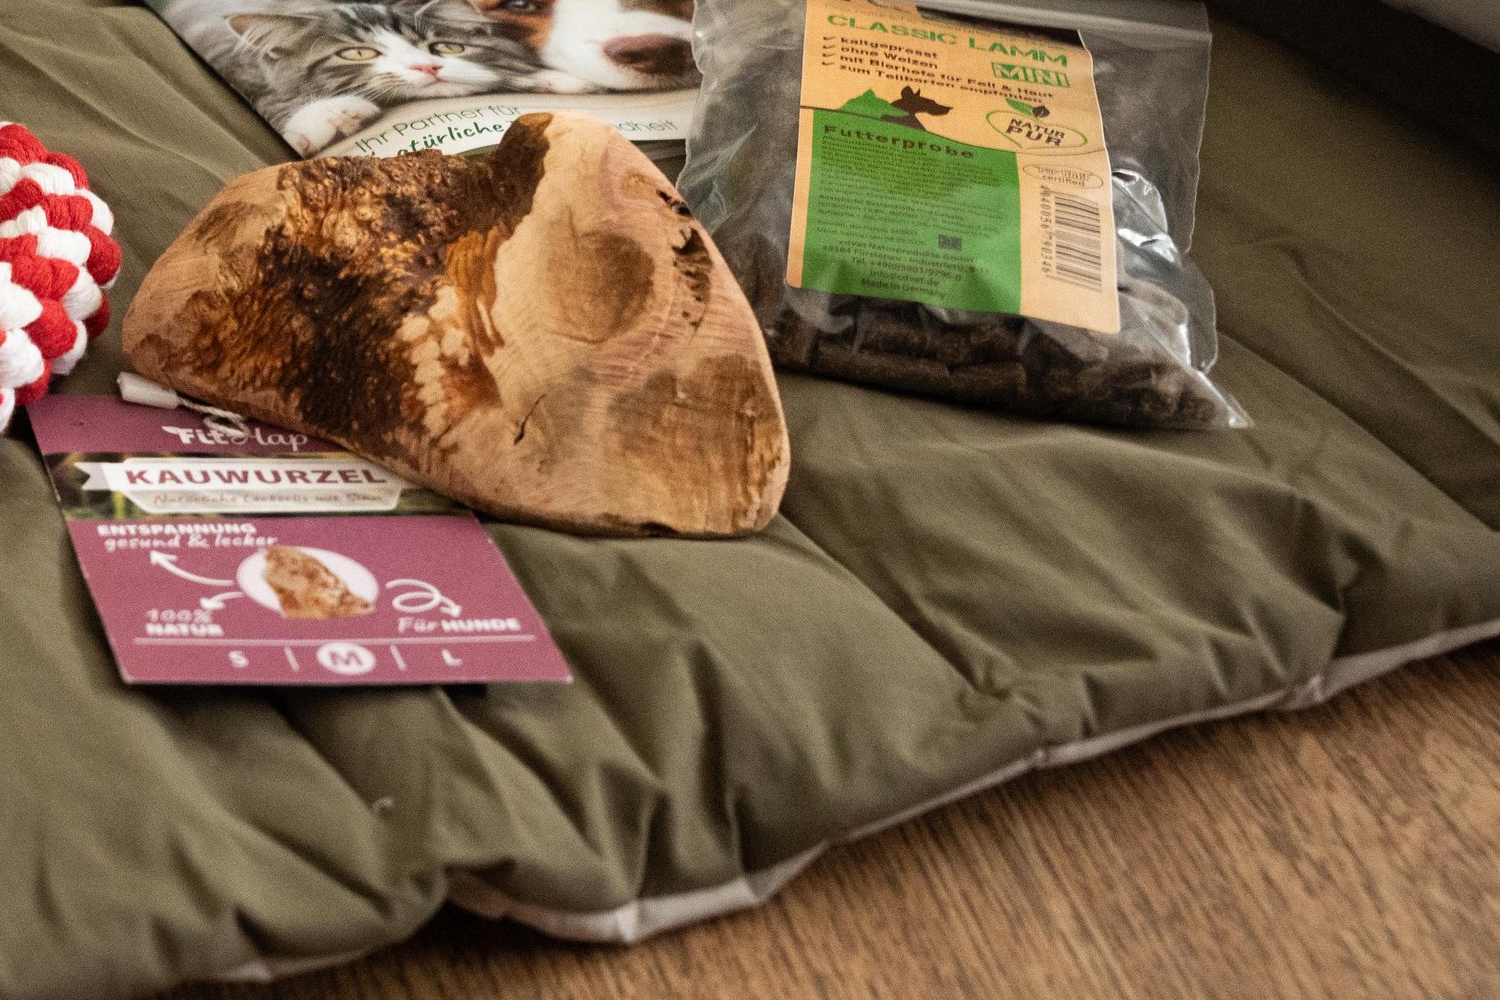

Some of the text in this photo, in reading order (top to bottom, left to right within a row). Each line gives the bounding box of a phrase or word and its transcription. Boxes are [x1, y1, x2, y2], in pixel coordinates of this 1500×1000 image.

[827, 14, 1068, 68] CLASSIC LAMM
[840, 37, 938, 59] kaltgepresst
[840, 46, 938, 69] ohne Weizen
[840, 55, 864, 64] mit
[355, 131, 389, 152] Ihr
[392, 108, 484, 136] Partner
[488, 105, 522, 117] für
[1006, 125, 1062, 147] PUR
[1010, 118, 1065, 139] NATUR
[370, 121, 505, 157] atürliche
[824, 125, 974, 158] Futterprobe
[125, 469, 387, 485] KAUWURZEL
[97, 523, 257, 537] ENTSPANNUNG
[104, 533, 278, 551] gesund & lecker
[146, 608, 212, 624] 100%
[398, 616, 521, 633] Für HUNDE
[145, 623, 224, 637] NATUR
[227, 648, 462, 668] S M L
